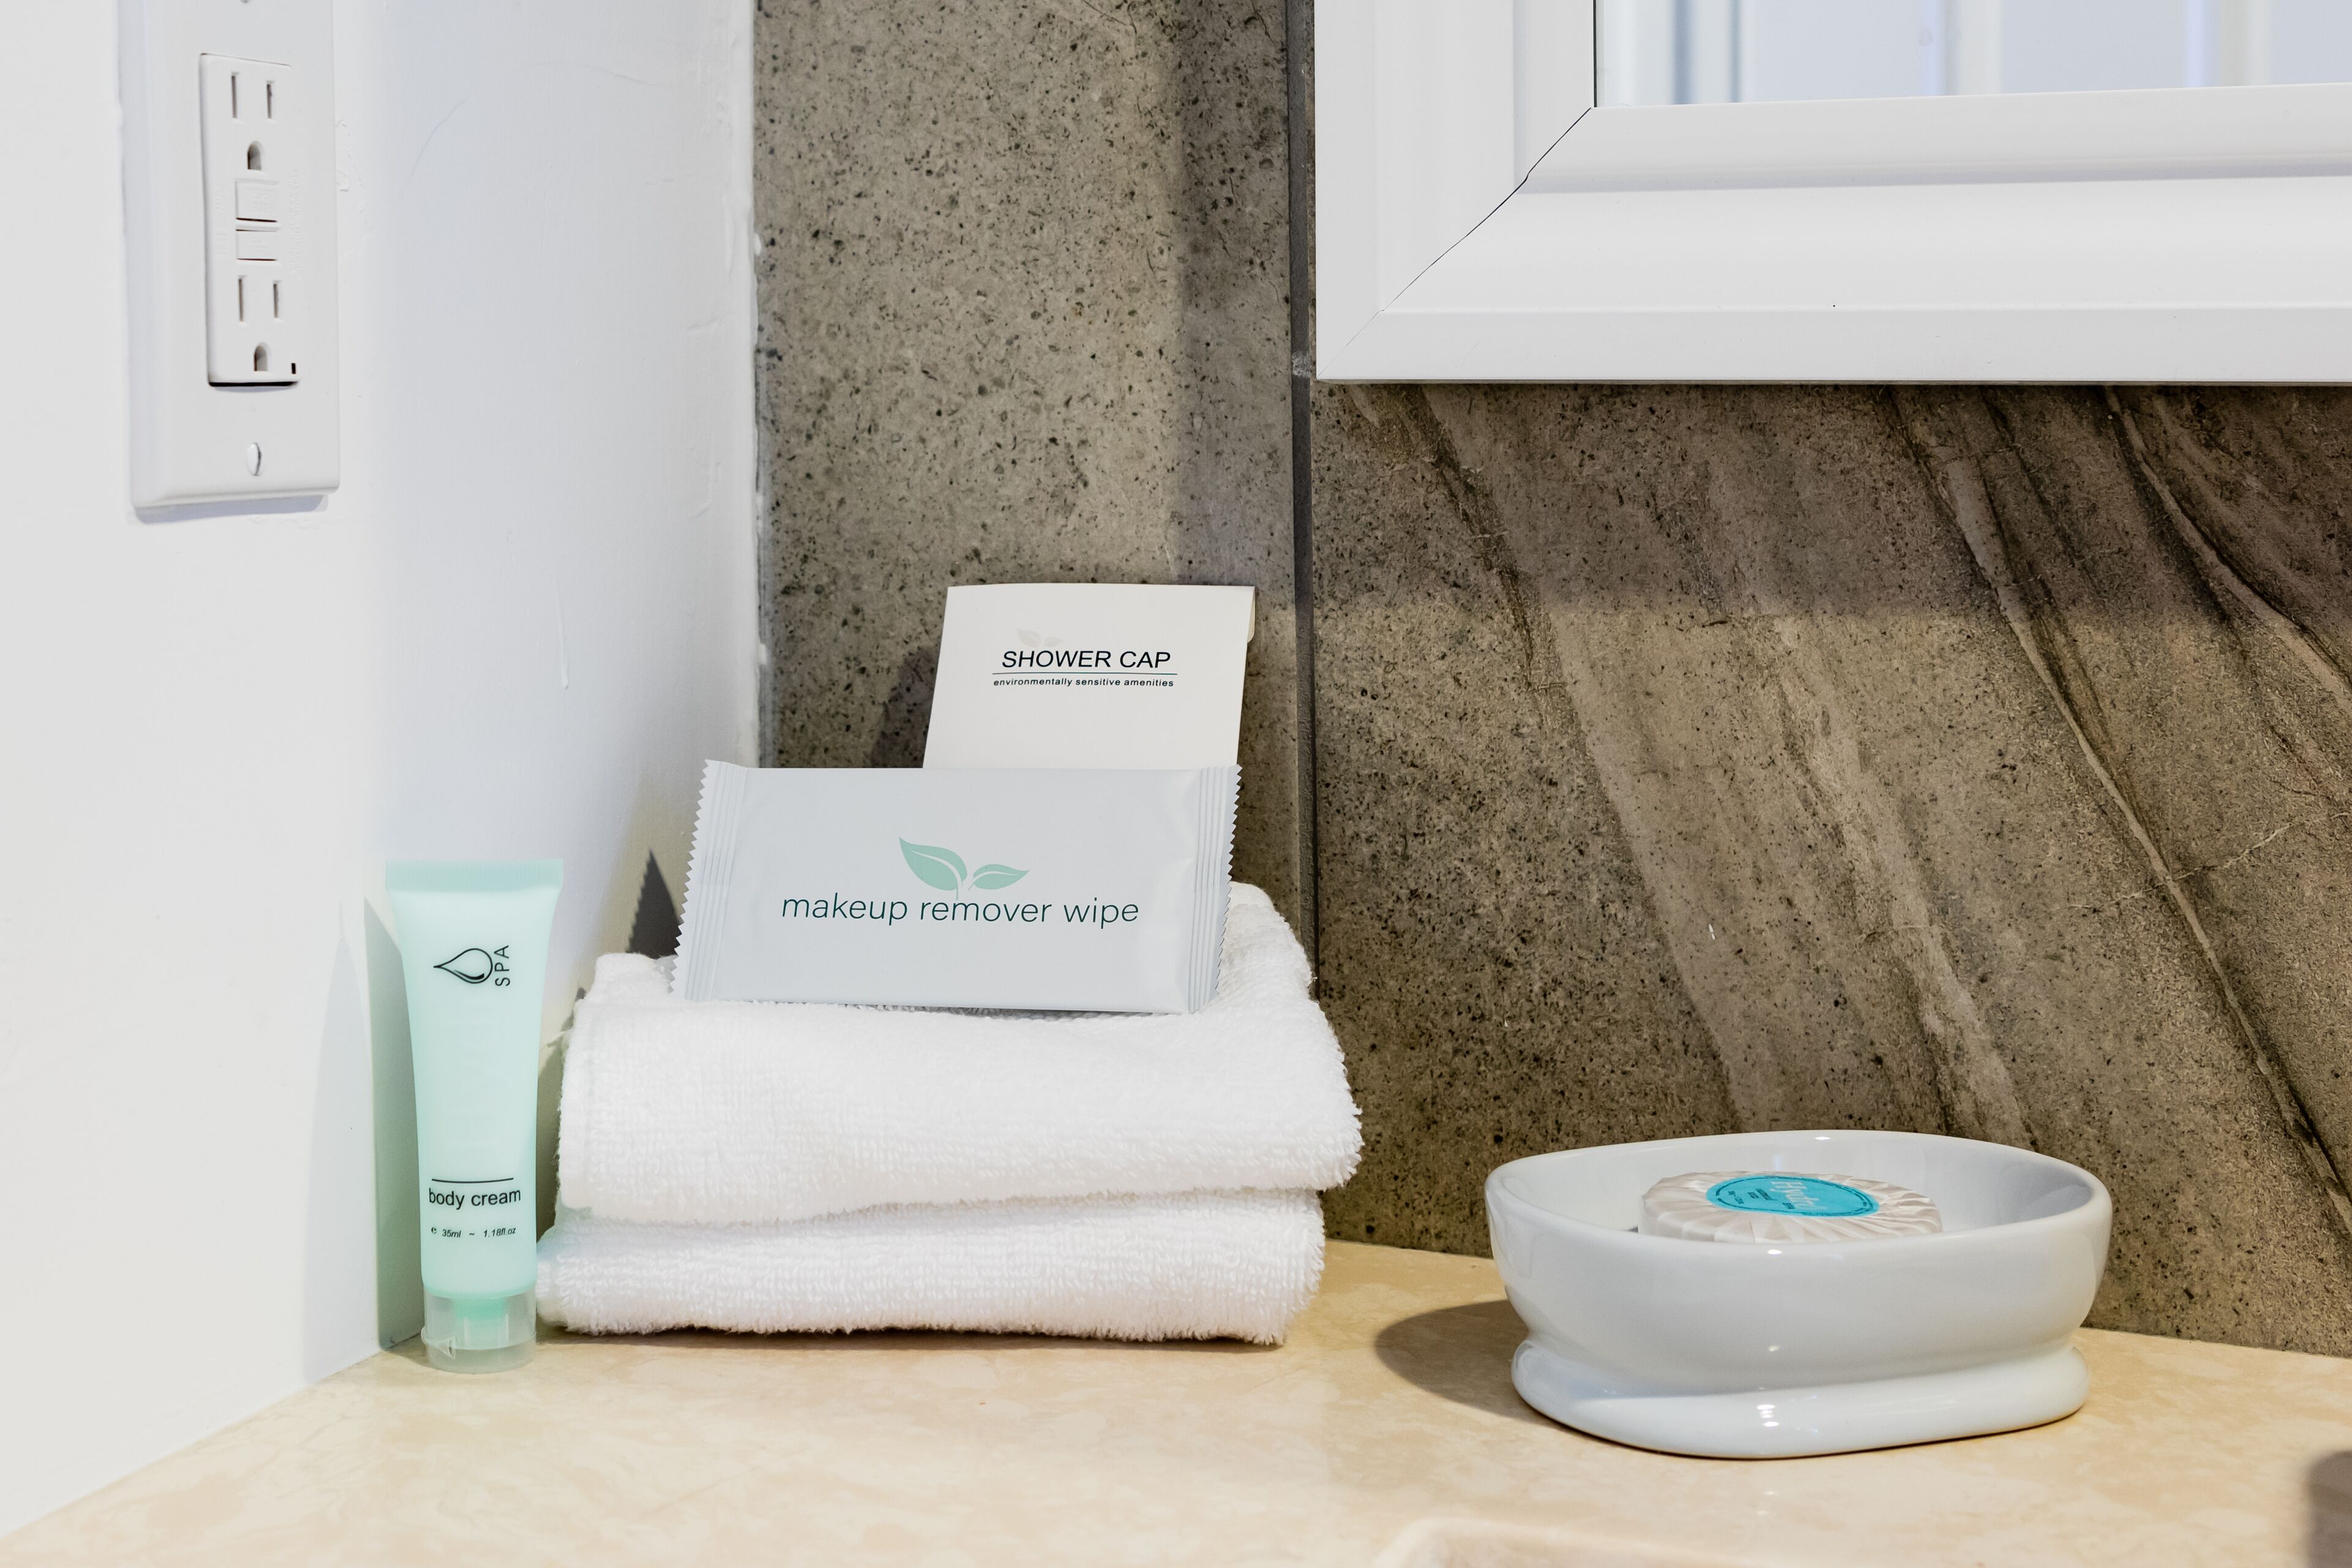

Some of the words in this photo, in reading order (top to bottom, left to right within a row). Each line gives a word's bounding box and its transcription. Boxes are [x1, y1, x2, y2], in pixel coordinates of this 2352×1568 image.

[1002, 650, 1112, 668] SHOWER
[1120, 650, 1171, 669] CAP
[993, 677, 1072, 687] environmentally
[1076, 677, 1121, 687] sensitive
[1124, 678, 1174, 687] amenities
[782, 892, 908, 926] makeup
[919, 900, 1052, 923] remover
[1063, 897, 1139, 930] wipe
[494, 944, 511, 987] SPA
[429, 1187, 466, 1210] body
[471, 1189, 521, 1206] cream
[442, 1229, 462, 1238] 35ml
